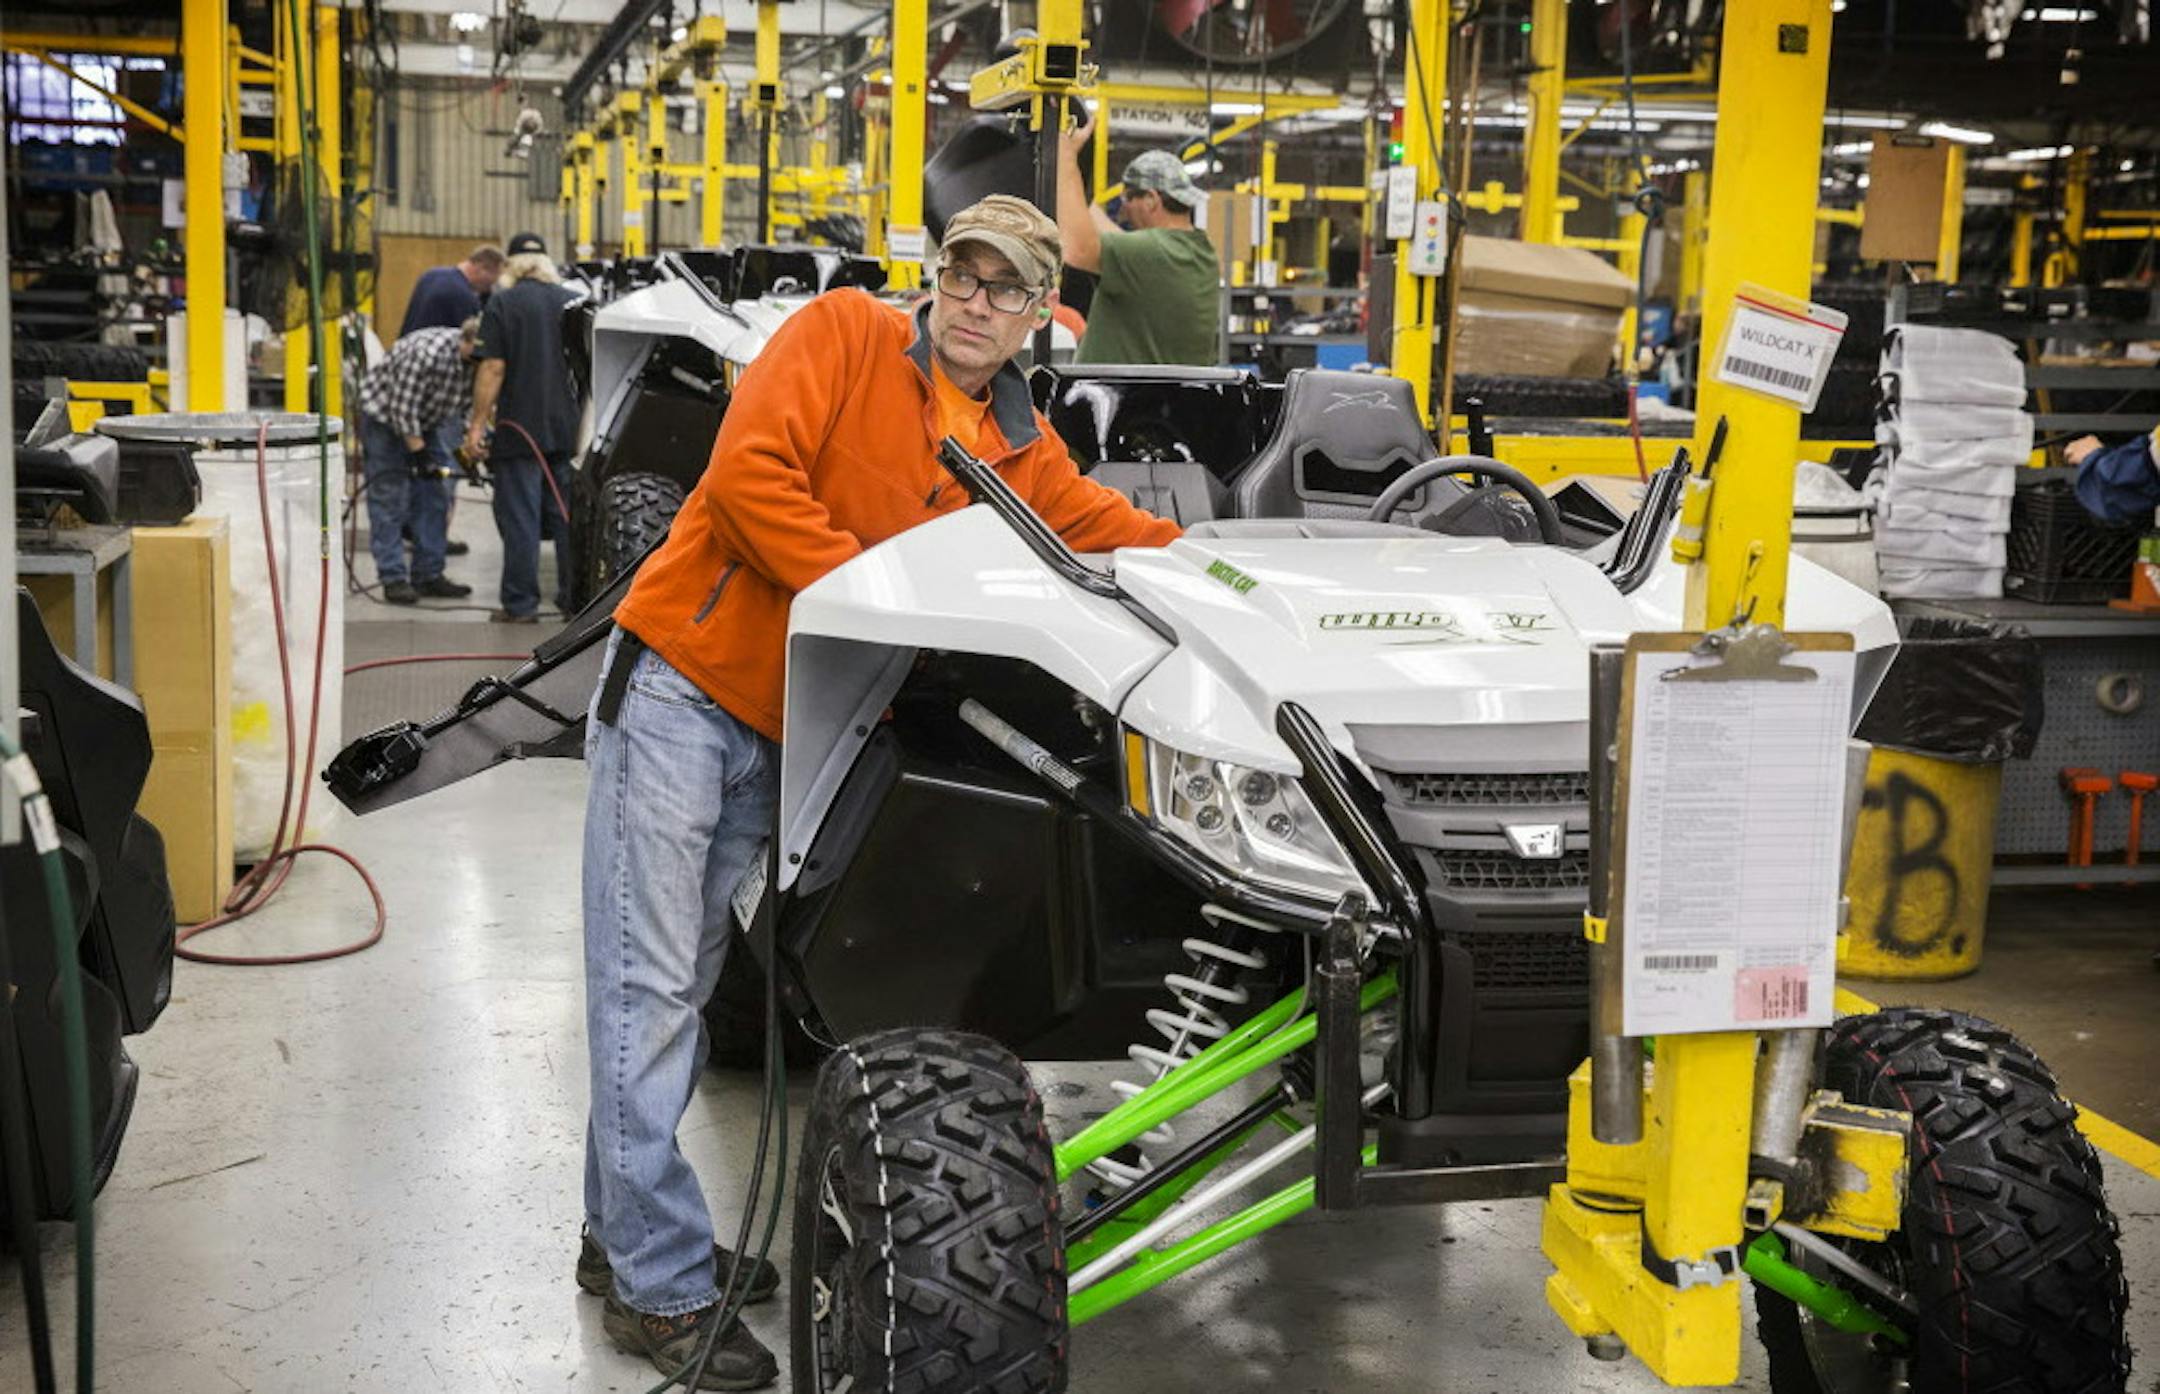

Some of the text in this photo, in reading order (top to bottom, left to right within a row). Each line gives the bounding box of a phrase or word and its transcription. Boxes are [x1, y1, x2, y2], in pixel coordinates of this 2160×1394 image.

[1111, 108, 1173, 123] STATION
[1741, 327, 1817, 359] WILDCAT X
[1206, 558, 1259, 596] ARCTIC CAT
